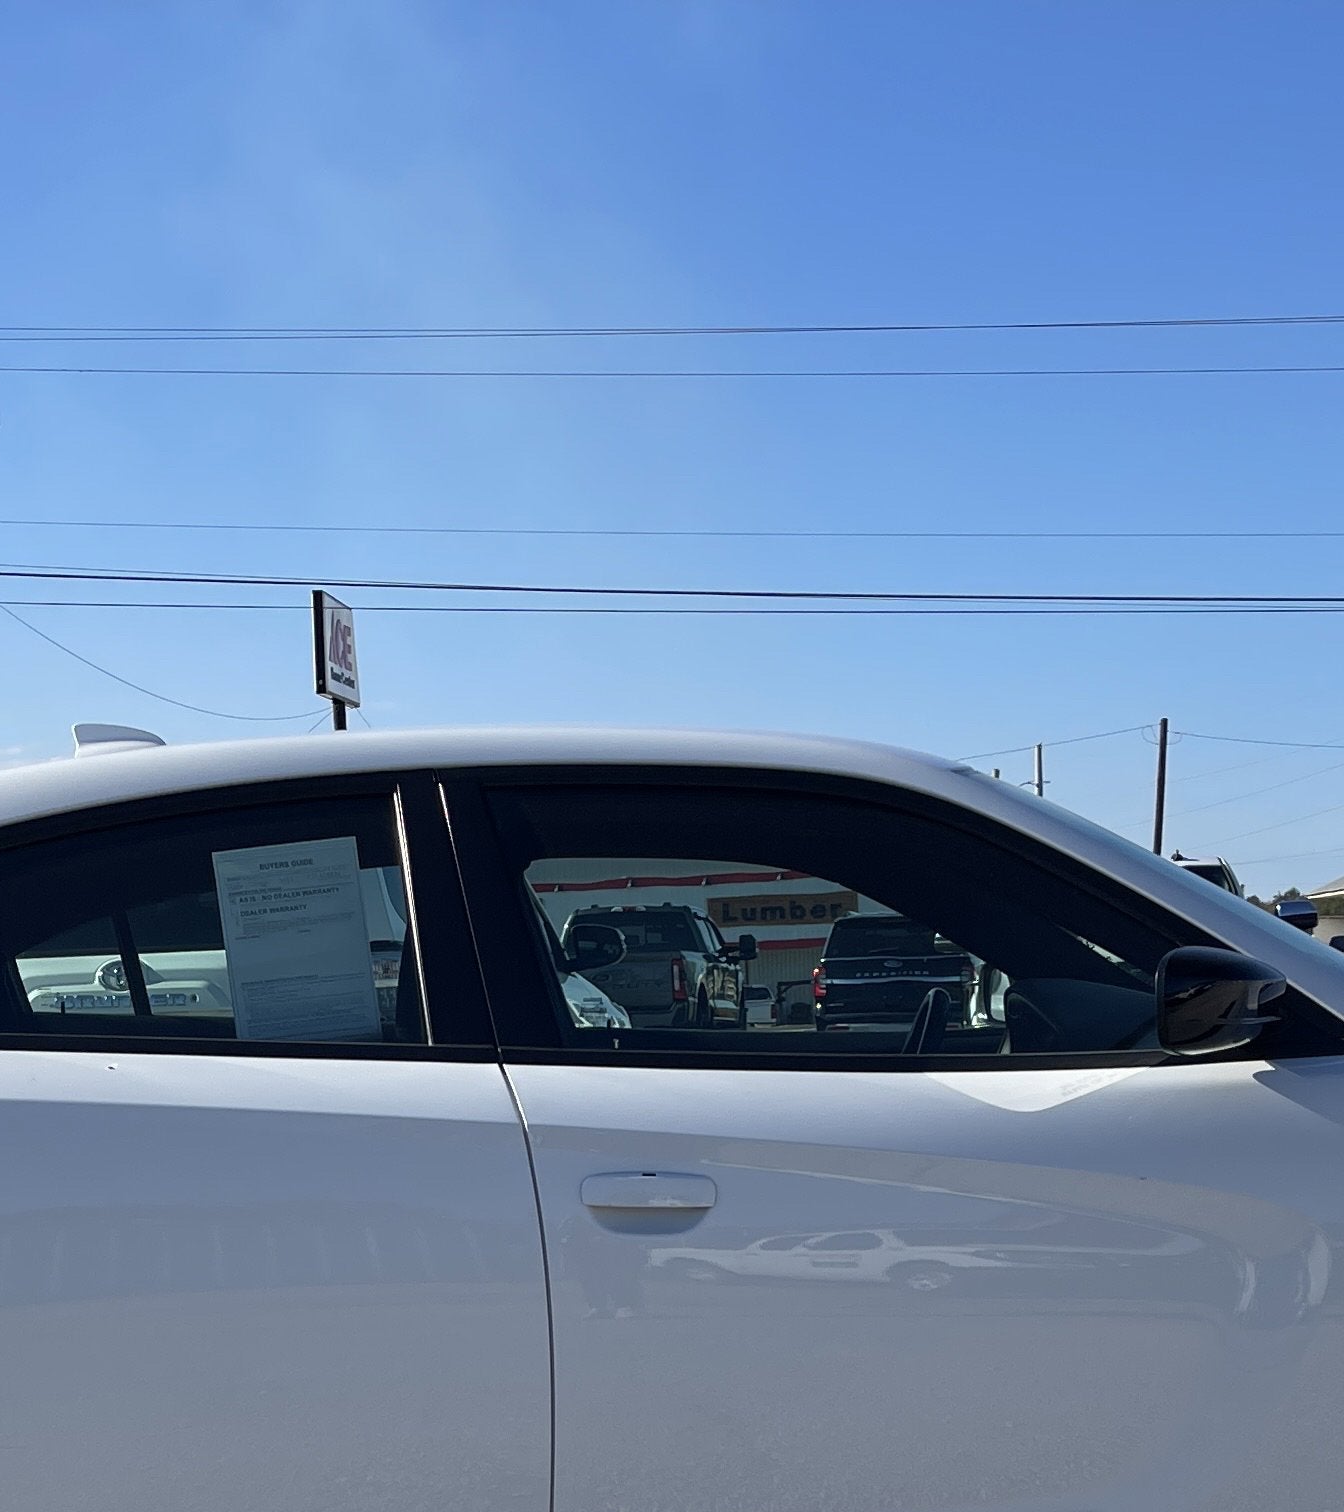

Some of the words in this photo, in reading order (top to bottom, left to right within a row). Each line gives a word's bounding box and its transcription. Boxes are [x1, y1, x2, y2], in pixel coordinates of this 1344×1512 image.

[259, 860, 290, 871] BUYERS
[290, 858, 314, 867] GUIDE
[273, 889, 301, 900] DEALER
[301, 886, 340, 897] WARRANTY
[240, 907, 268, 918] DEALER
[269, 904, 308, 914] WARRANTY
[722, 900, 842, 923] Lumber
